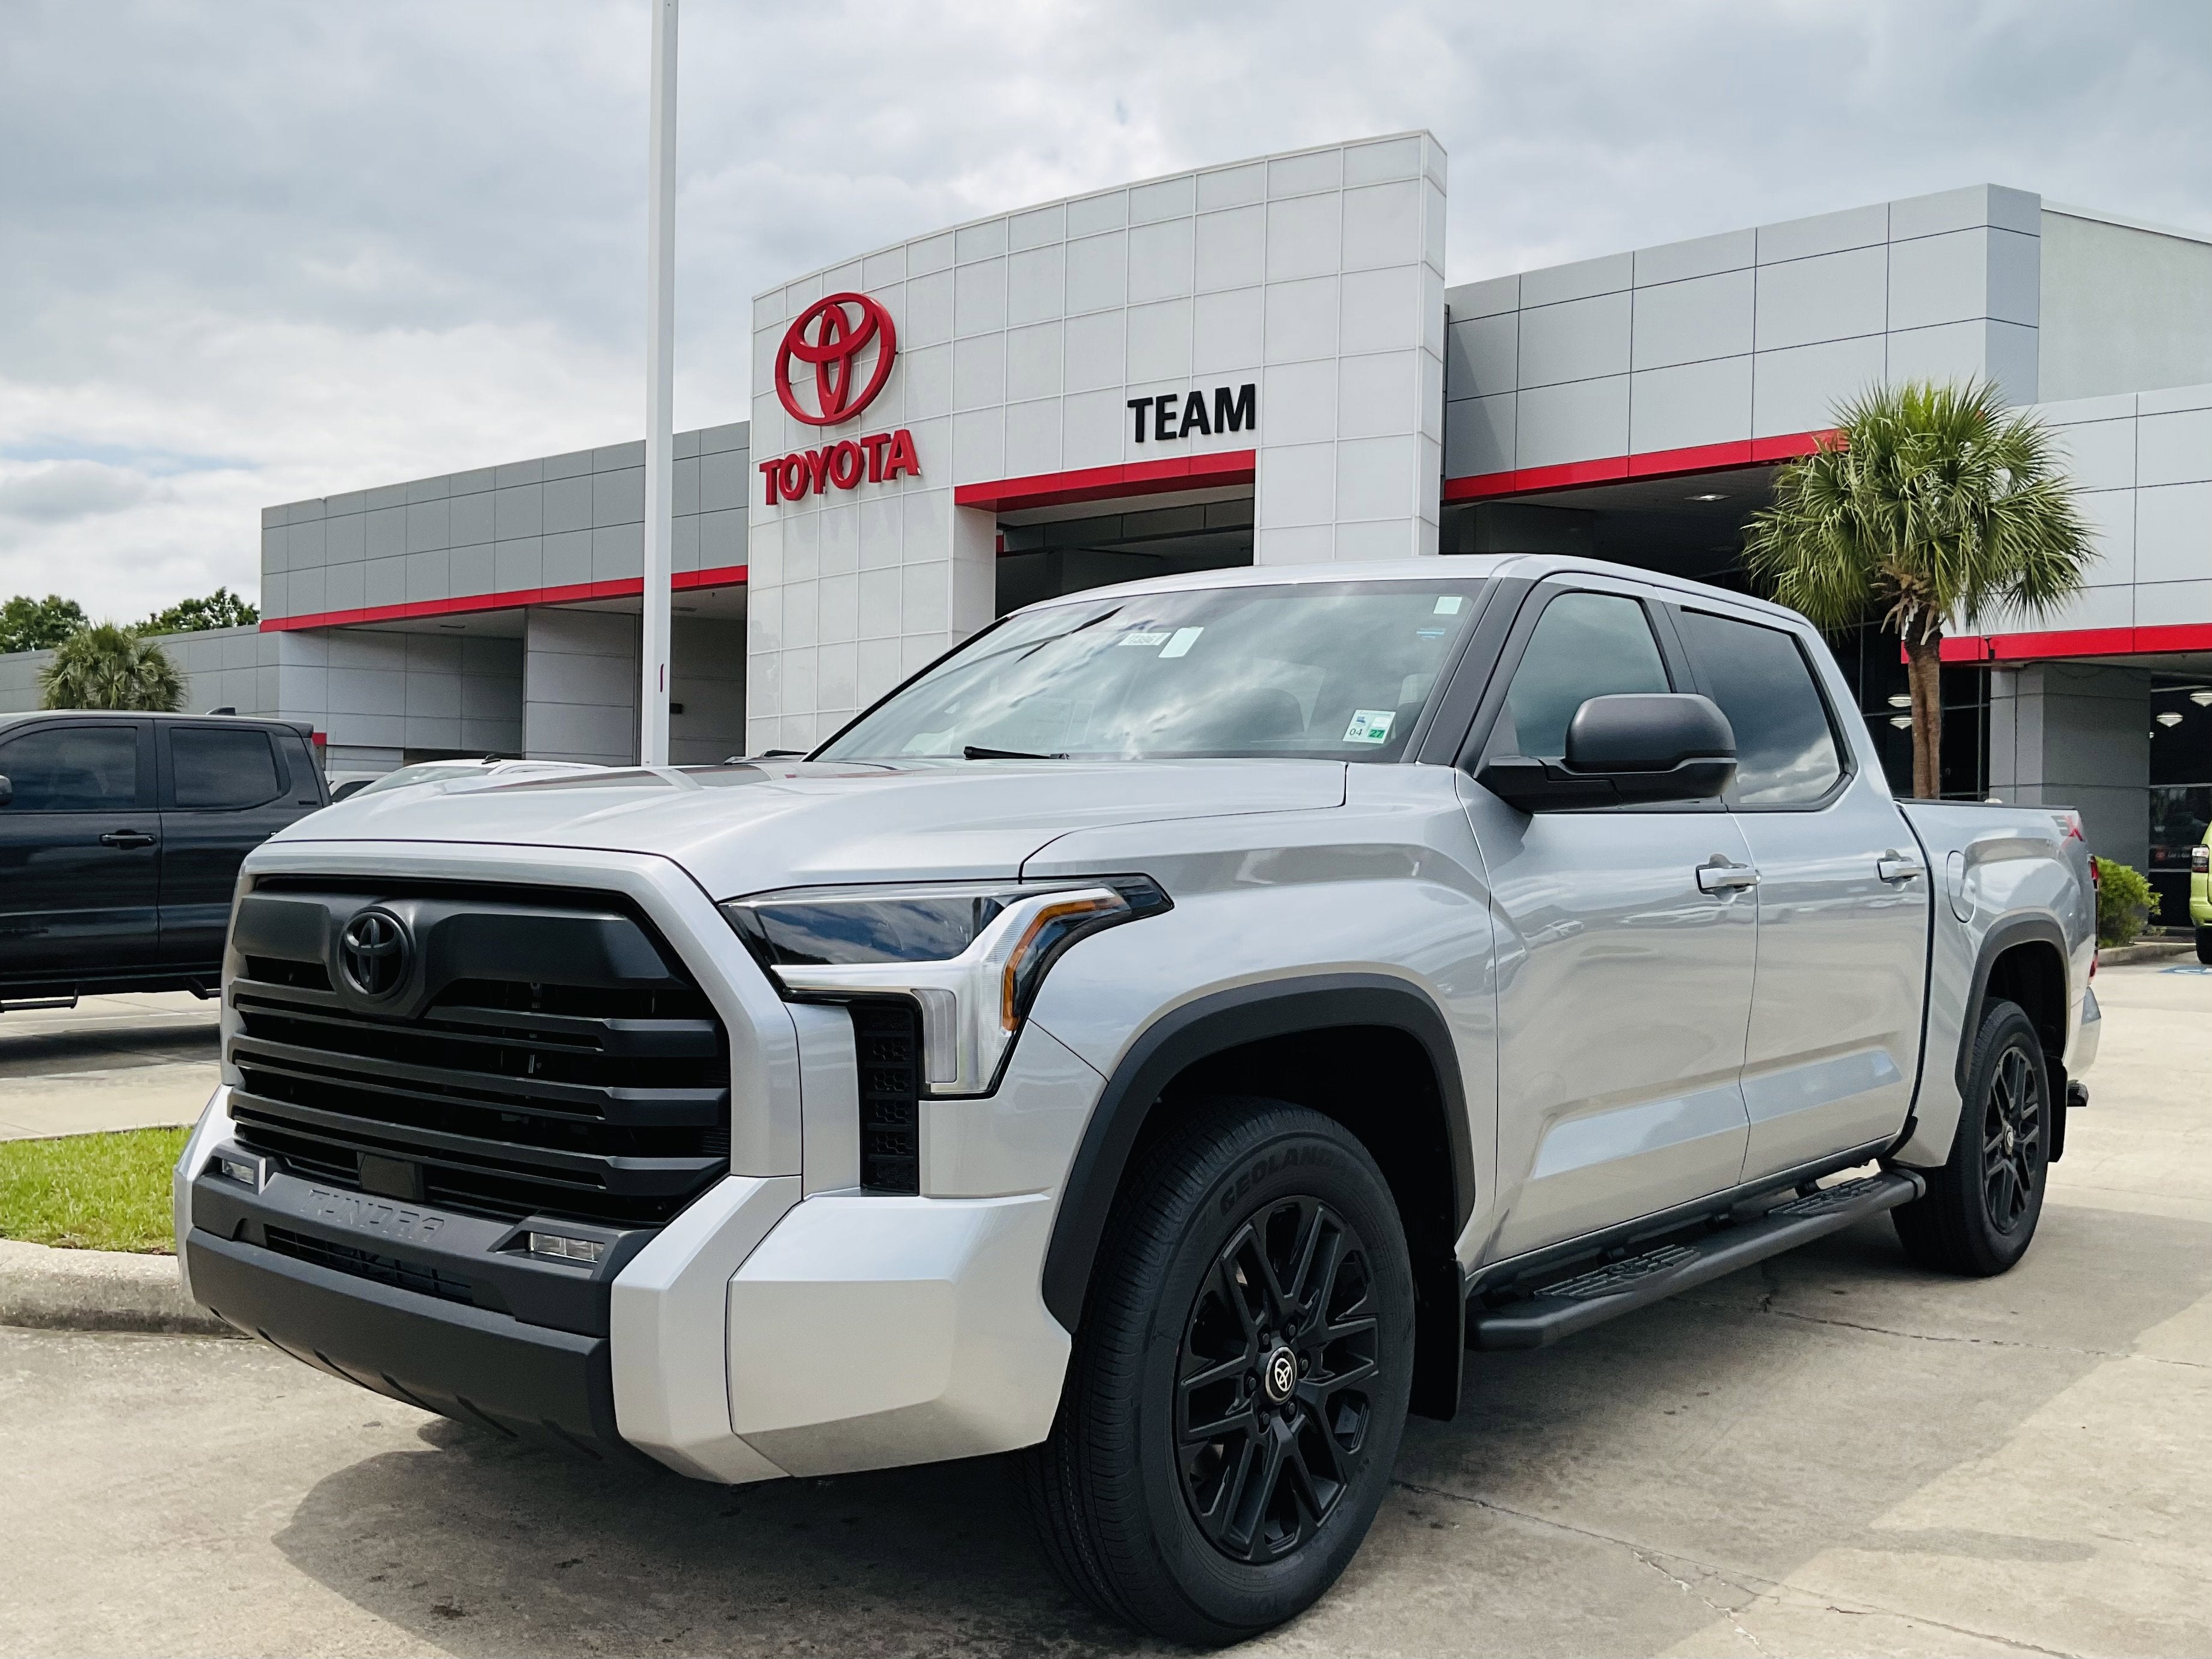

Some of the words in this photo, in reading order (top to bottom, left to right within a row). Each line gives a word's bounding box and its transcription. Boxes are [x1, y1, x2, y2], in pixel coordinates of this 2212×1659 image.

[1127, 383, 1256, 443] TEAM
[759, 429, 921, 506] TOYOTA
[1369, 729, 1384, 738] 27
[300, 1189, 445, 1242] TUNDRA
